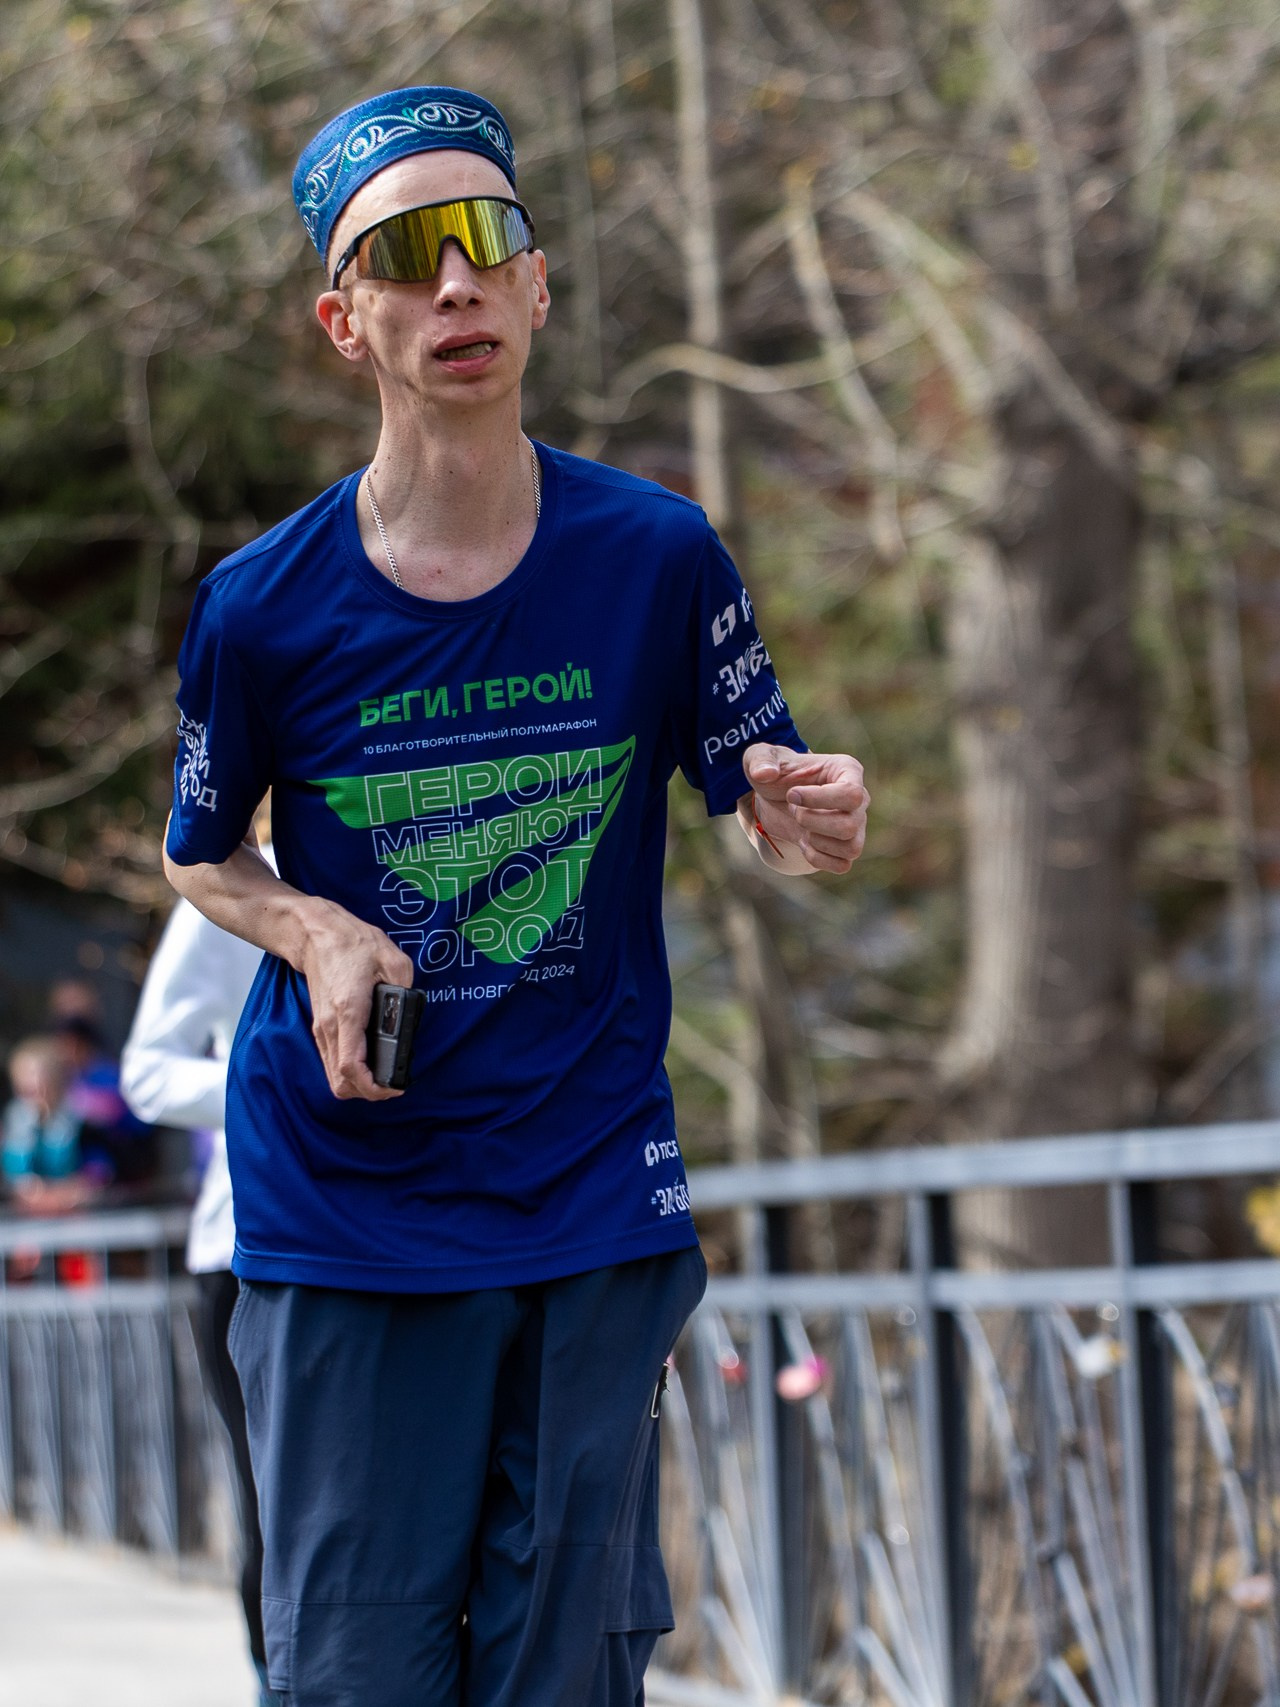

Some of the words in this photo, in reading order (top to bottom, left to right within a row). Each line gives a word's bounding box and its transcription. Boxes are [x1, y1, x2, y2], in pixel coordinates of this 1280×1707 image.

[359, 686, 458, 727] БЕГИ,
[463, 662, 593, 713] ГЕРОЙ!
[363, 746, 375, 754] 10
[375, 727, 509, 754] БЛАГОТВОРИТЕЛЬНЫЙ
[510, 718, 598, 737] ПОЛУМАРАФОН
[364, 747, 602, 825] ГЕРОИ
[372, 803, 602, 864] МЕНЯЮТ
[379, 844, 596, 926] ЭТОТ
[541, 964, 575, 980] 2024
